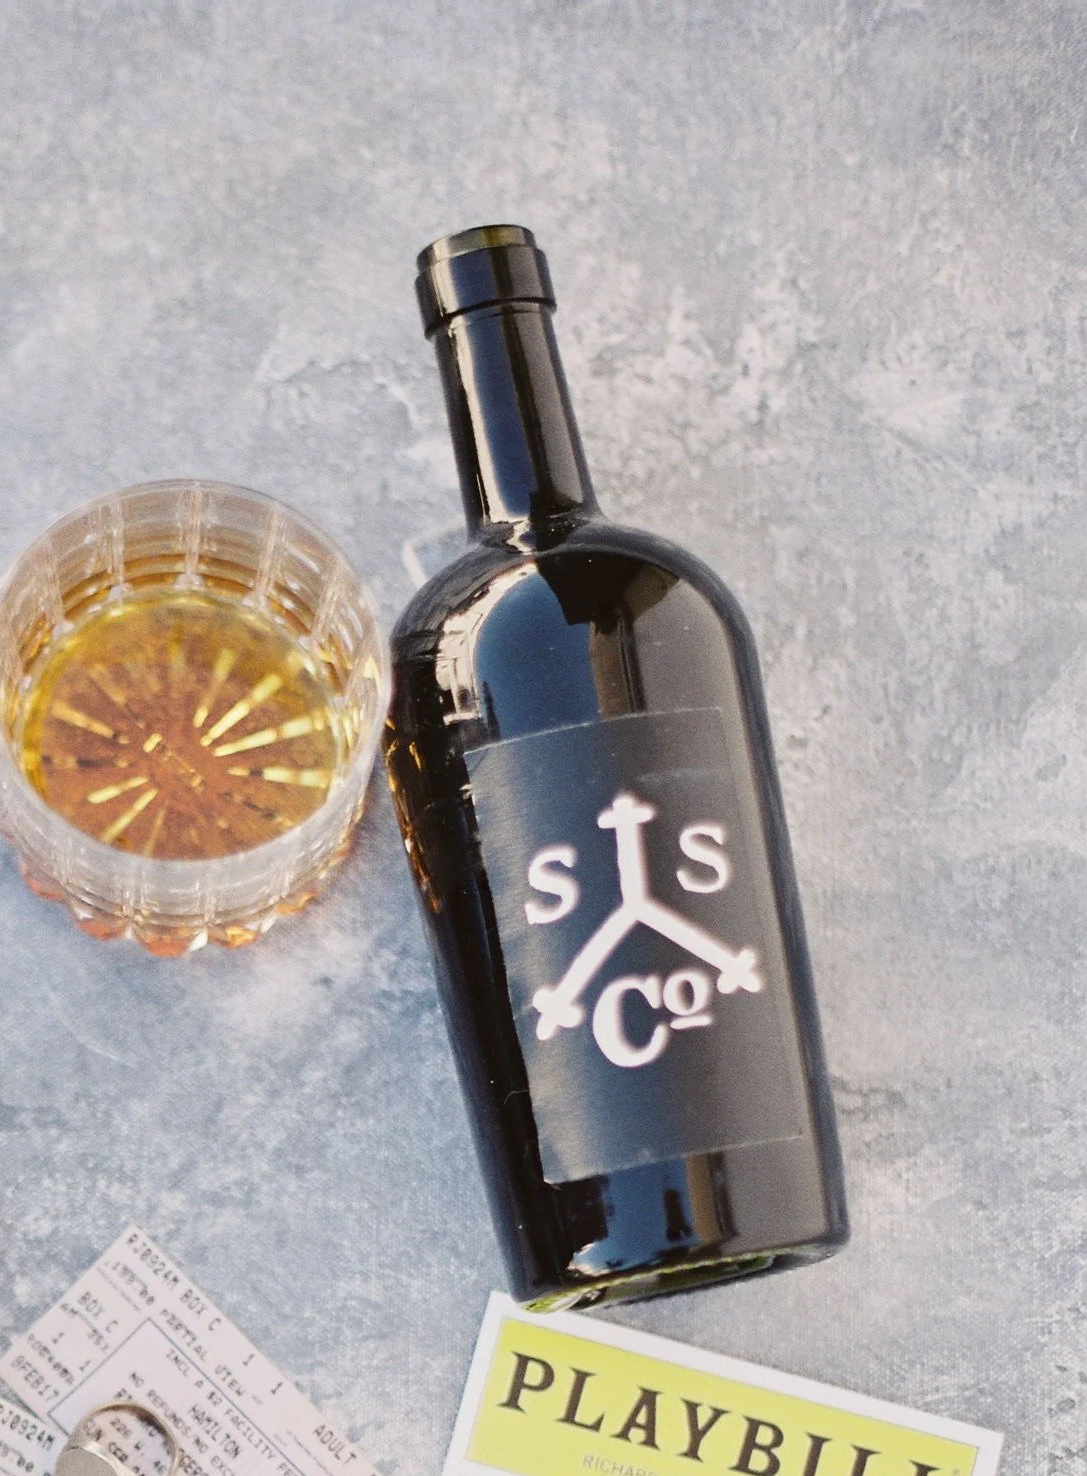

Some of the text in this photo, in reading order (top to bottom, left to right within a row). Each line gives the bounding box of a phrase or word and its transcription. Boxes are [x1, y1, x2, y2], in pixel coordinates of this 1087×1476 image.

[523, 822, 730, 925] S S
[52, 1331, 91, 1370] 1 1
[78, 1292, 104, 1318] BOX
[105, 1319, 118, 1333] C
[123, 1233, 181, 1289] RJ0924M
[179, 1289, 208, 1318] BOX
[207, 1317, 221, 1331] C
[243, 1353, 255, 1366] 1
[271, 1381, 283, 1394] 1
[312, 1423, 356, 1467] ADULT
[128, 1372, 144, 1388] NO
[144, 1389, 210, 1454] REFUNDS/NO
[165, 1349, 192, 1376] INCL
[194, 1378, 204, 1388] A
[206, 1390, 222, 1407] $2
[223, 1408, 276, 1461] FACILITY
[186, 1404, 242, 1459] HAMILTON
